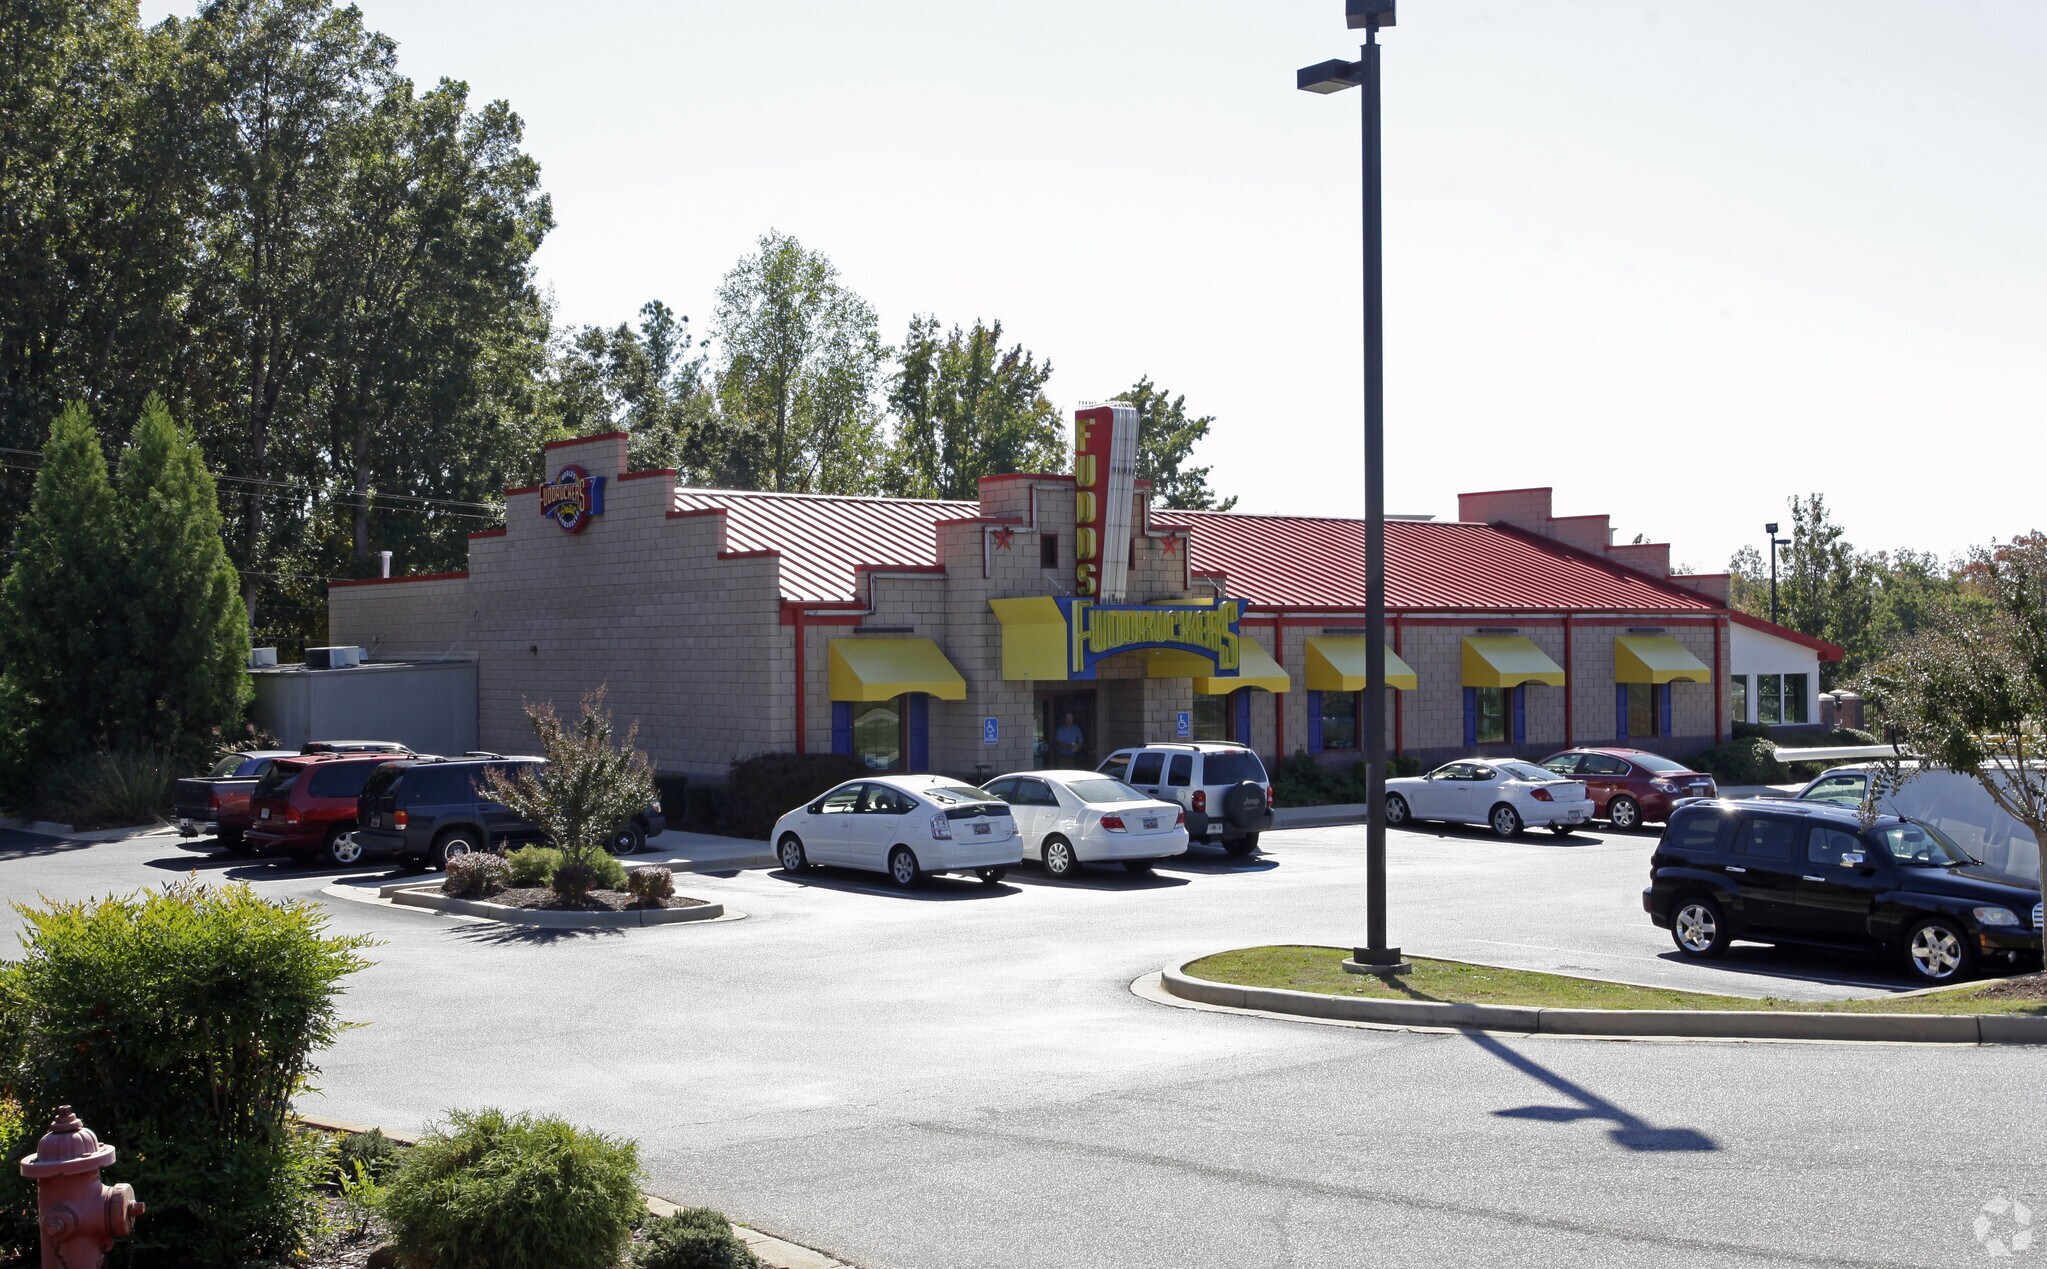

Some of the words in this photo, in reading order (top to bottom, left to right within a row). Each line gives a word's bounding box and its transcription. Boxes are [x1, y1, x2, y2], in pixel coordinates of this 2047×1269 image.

[539, 478, 585, 516] FUDDRUCKERS
[1075, 418, 1096, 596] FUDDS
[1072, 600, 1238, 672] FUDDRUCKERS
[1243, 797, 1260, 806] Jeep
